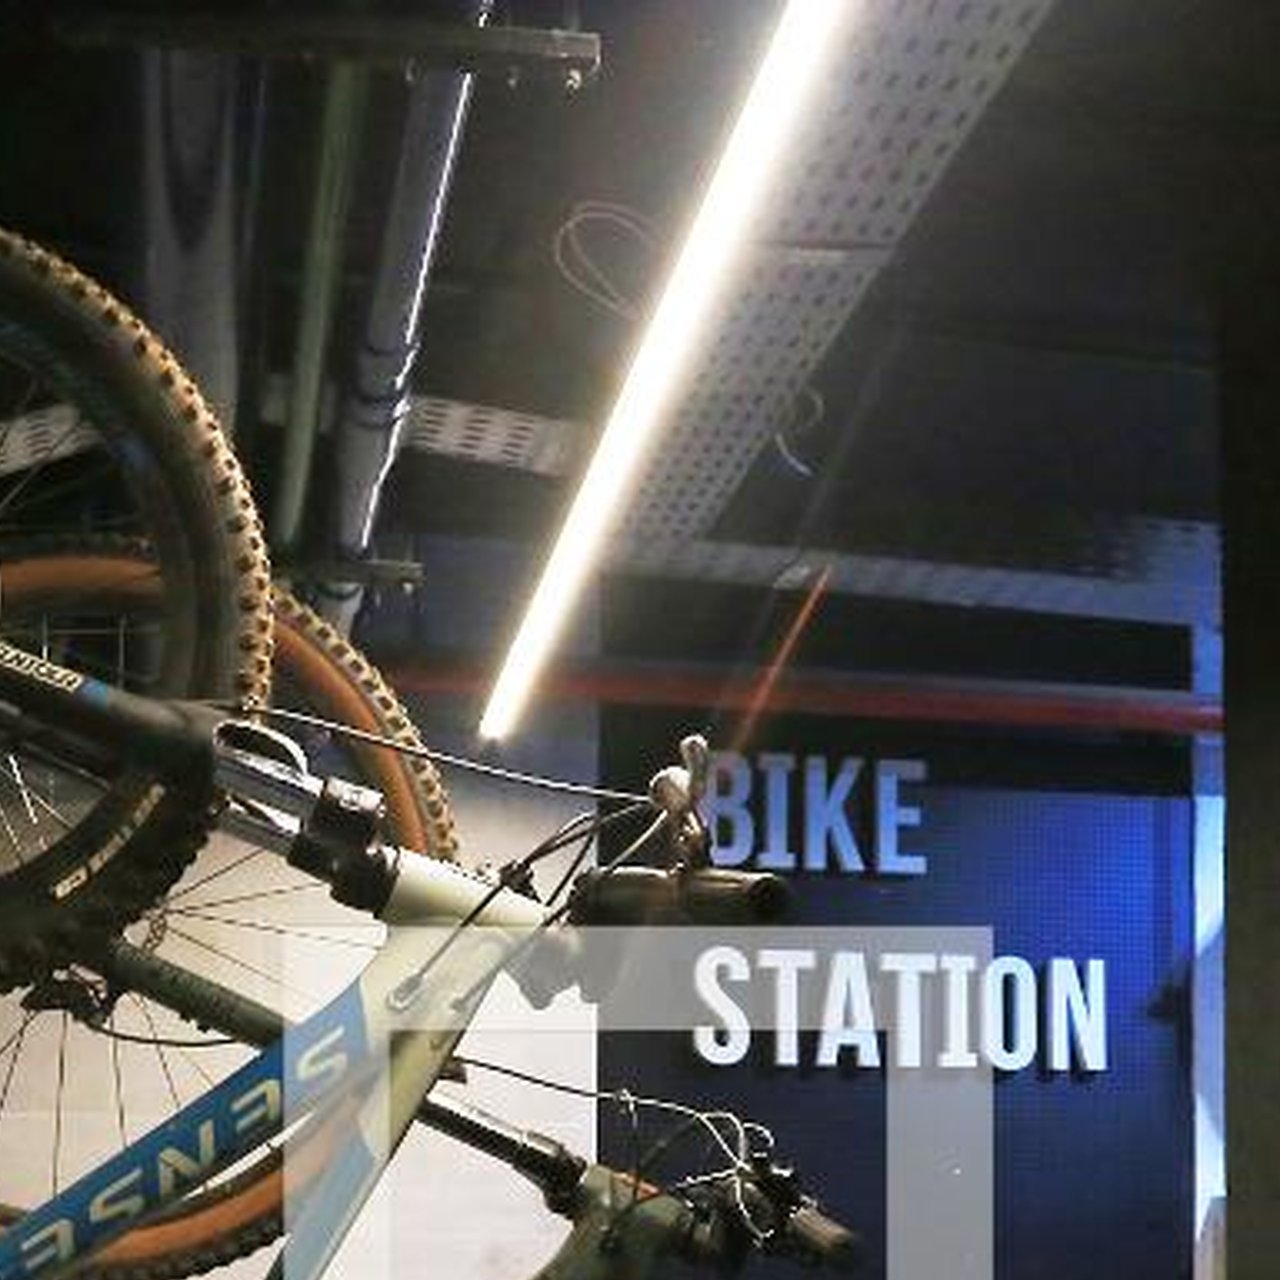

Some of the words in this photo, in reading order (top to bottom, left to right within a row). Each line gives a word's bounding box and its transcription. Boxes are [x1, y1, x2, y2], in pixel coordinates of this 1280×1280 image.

[706, 749, 928, 874] BIKE
[692, 945, 1110, 1071] STATION
[20, 1026, 346, 1271] SENSE
